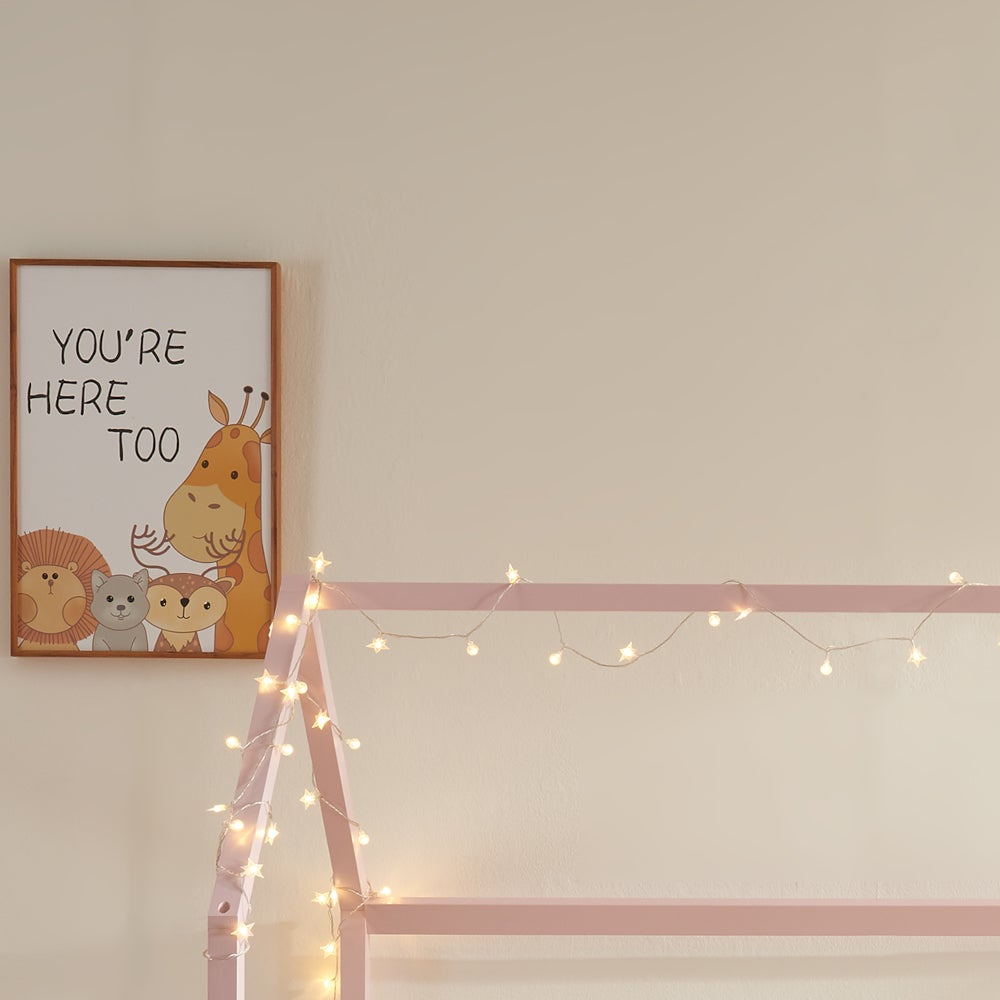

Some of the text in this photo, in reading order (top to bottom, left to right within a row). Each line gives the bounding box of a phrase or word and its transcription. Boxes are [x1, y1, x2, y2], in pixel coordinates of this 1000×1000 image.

[52, 327, 187, 366] YOU'RE
[27, 378, 128, 416] HERE
[107, 426, 180, 463] TOO
